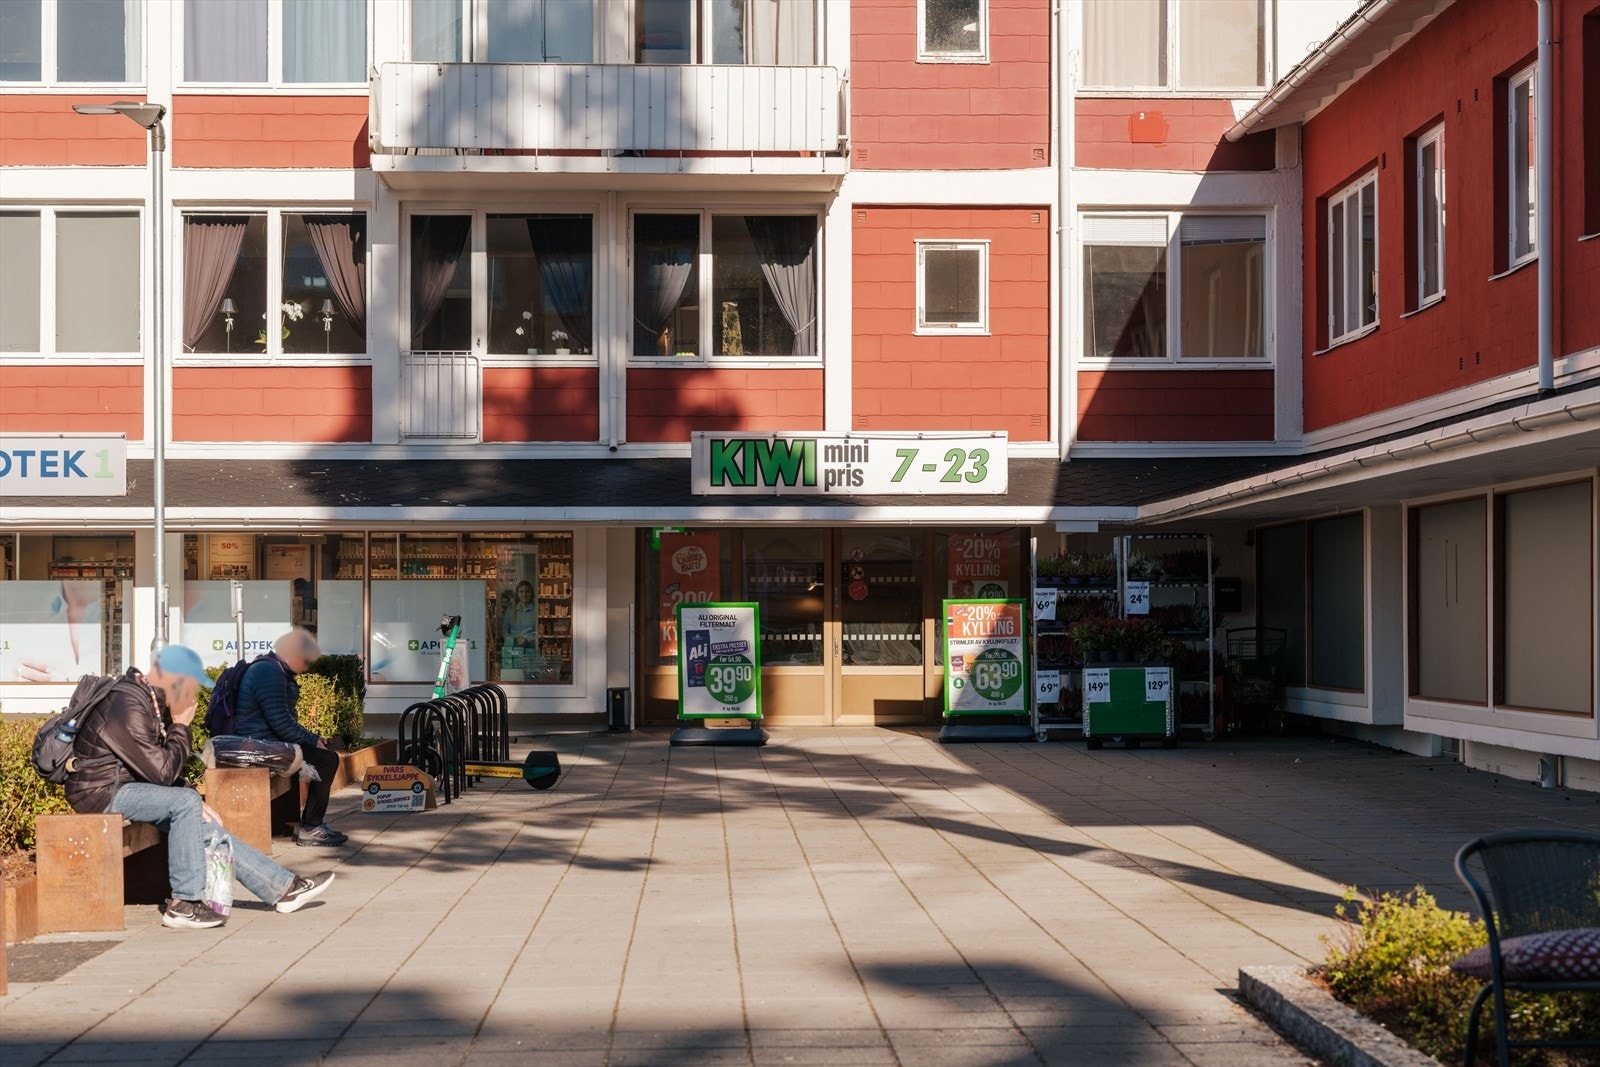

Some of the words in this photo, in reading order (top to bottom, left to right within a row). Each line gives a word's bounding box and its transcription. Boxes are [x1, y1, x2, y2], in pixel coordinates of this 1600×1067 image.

[94, 449, 114, 478] 1
[710, 439, 818, 487] KIWI
[824, 439, 869, 463] mini
[824, 464, 864, 492] pris
[957, 538, 1001, 559] -20%
[956, 563, 1000, 576] KYLLING
[963, 606, 997, 621] -20%
[962, 620, 1014, 636] KYLLING
[470, 640, 477, 650] 1
[367, 773, 420, 782] SYKKELSJAPPE
